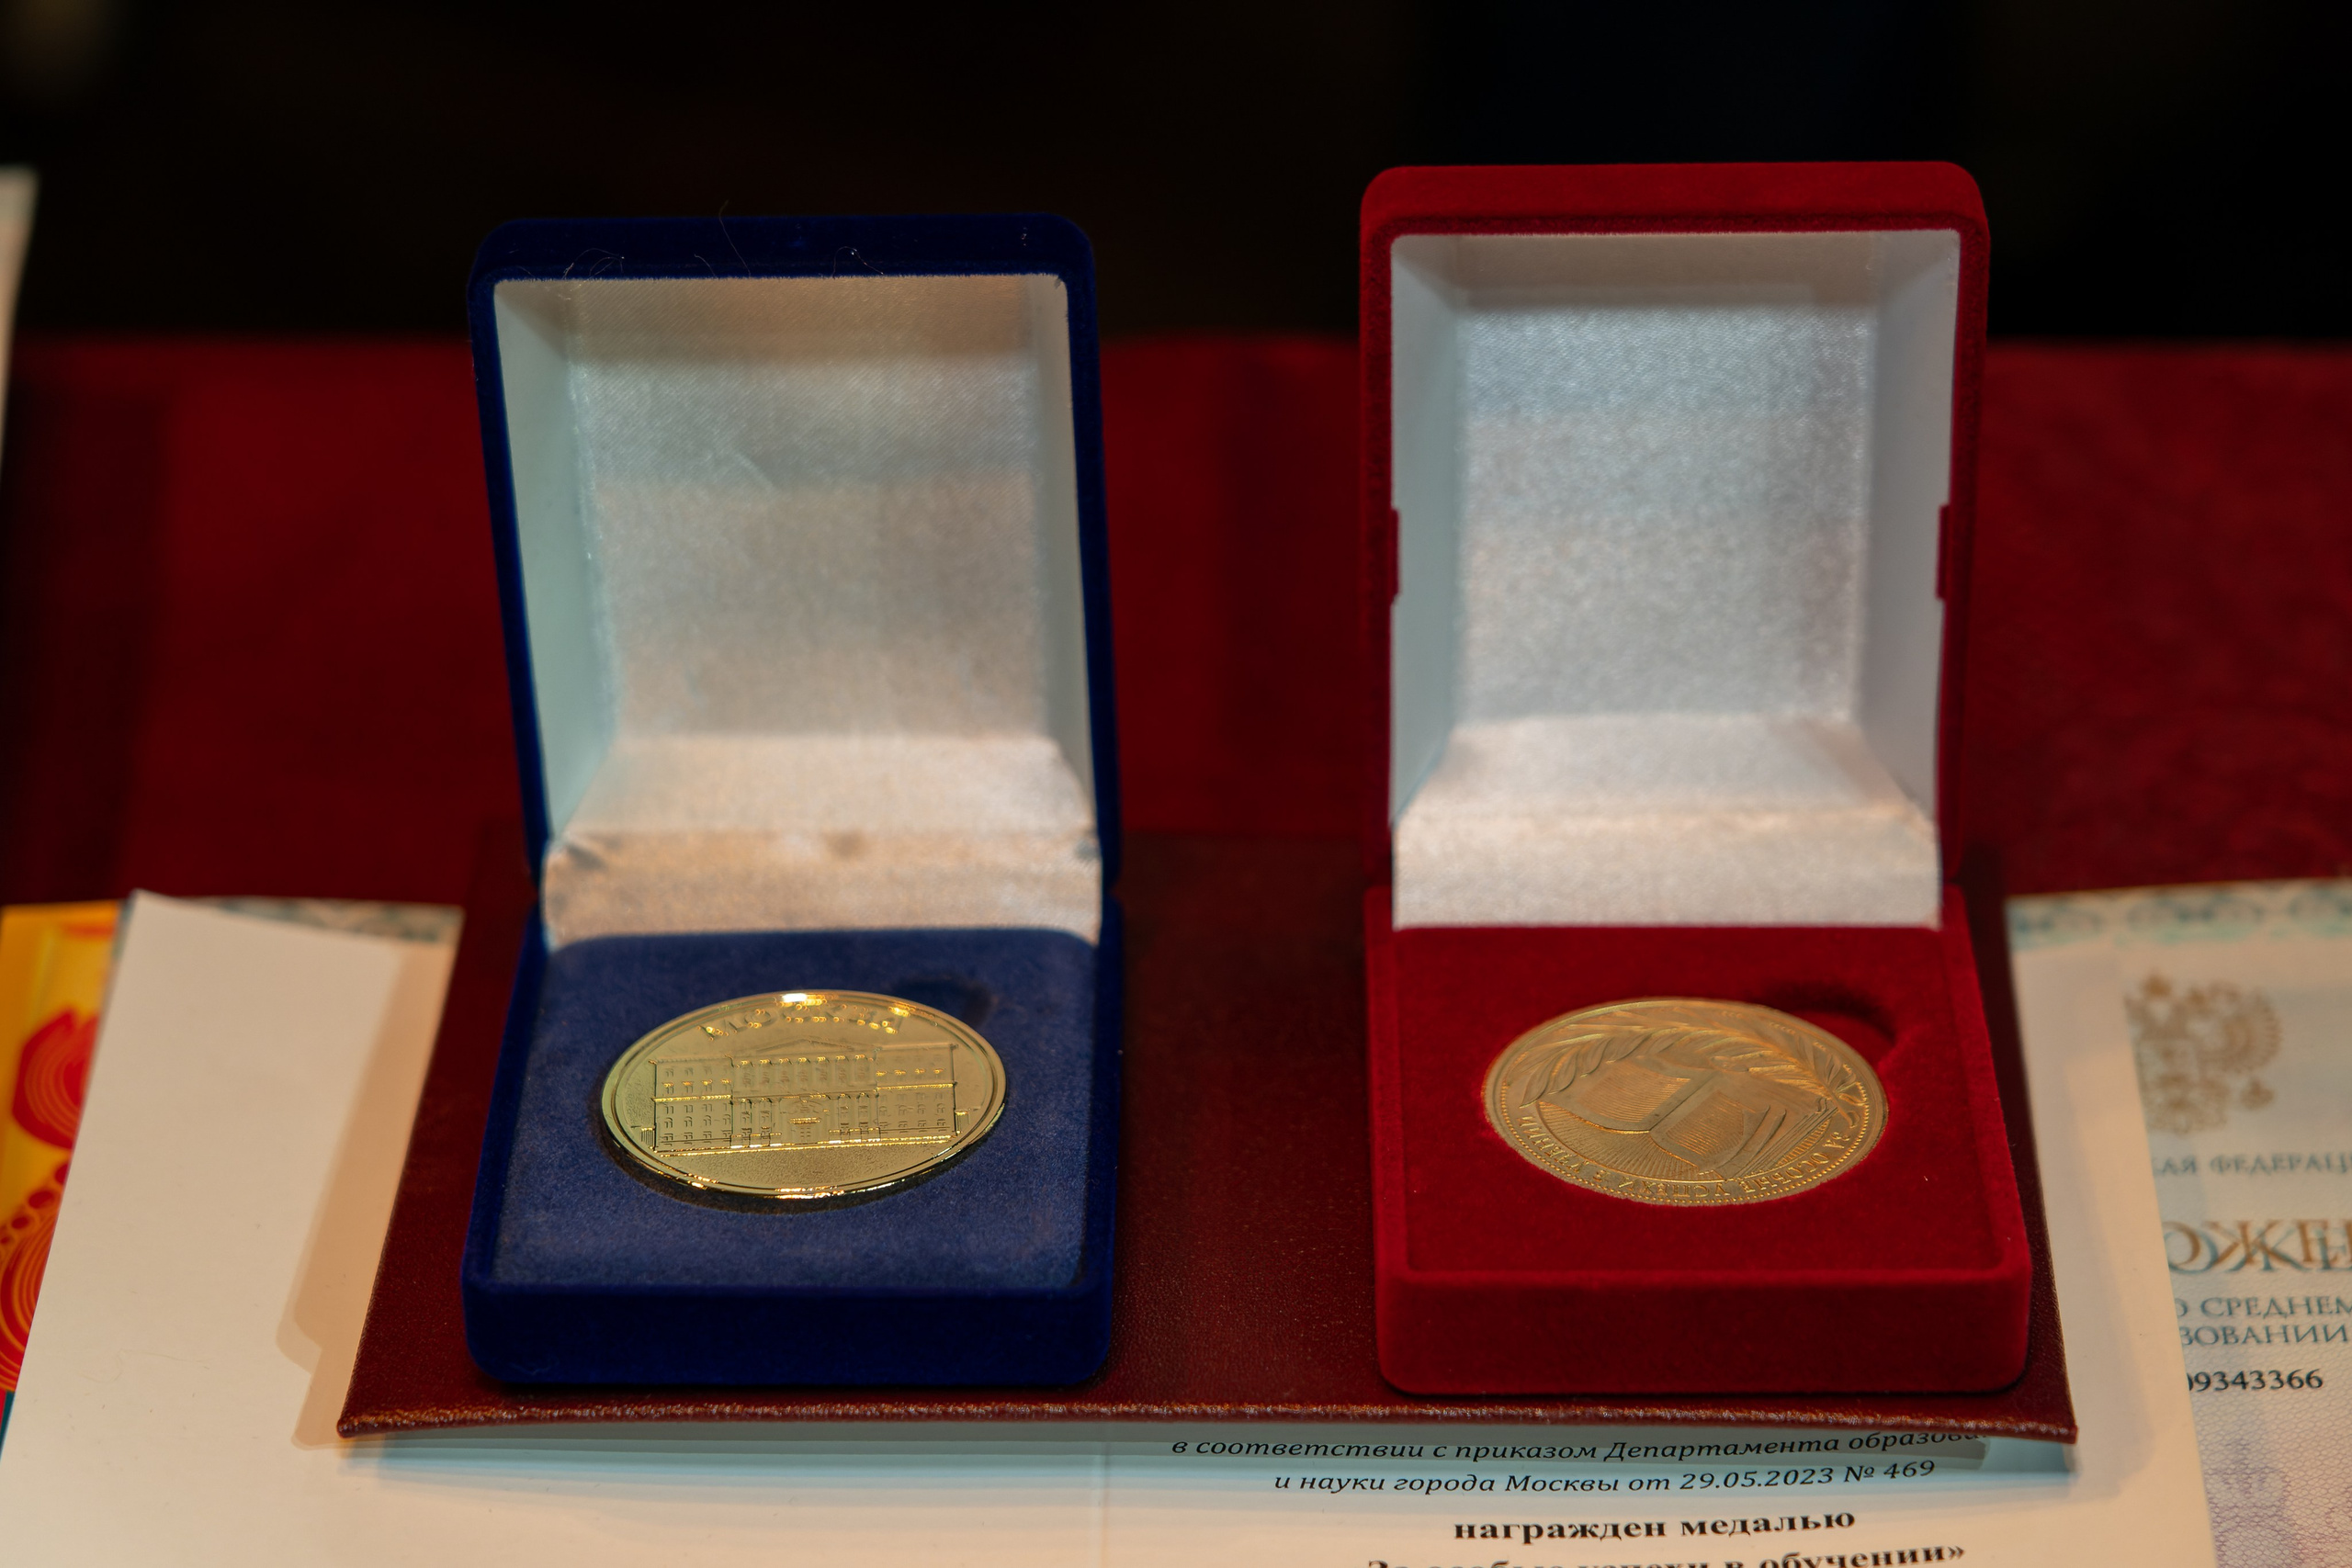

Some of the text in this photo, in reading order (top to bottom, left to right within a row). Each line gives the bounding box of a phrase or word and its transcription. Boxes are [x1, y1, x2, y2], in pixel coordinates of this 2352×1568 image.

[1737, 1151, 1829, 1193] ОСОБЫЕ
[2210, 1153, 2352, 1175] ФЕДЕРАЦ
[1617, 1177, 1731, 1198] УСПЕХИ
[2162, 1219, 2352, 1273] ОЖЕ
[1171, 1441, 1188, 1454] в
[1196, 1440, 1423, 1460] соответствии
[1432, 1444, 1447, 1459] с
[1456, 1444, 1597, 1463] приказом
[1603, 1436, 1838, 1462] Департамента
[1274, 1460, 1935, 1495] и науки города Москвы от 29.05.2023 № 469
[1453, 1511, 1856, 1544] награжден медалью
